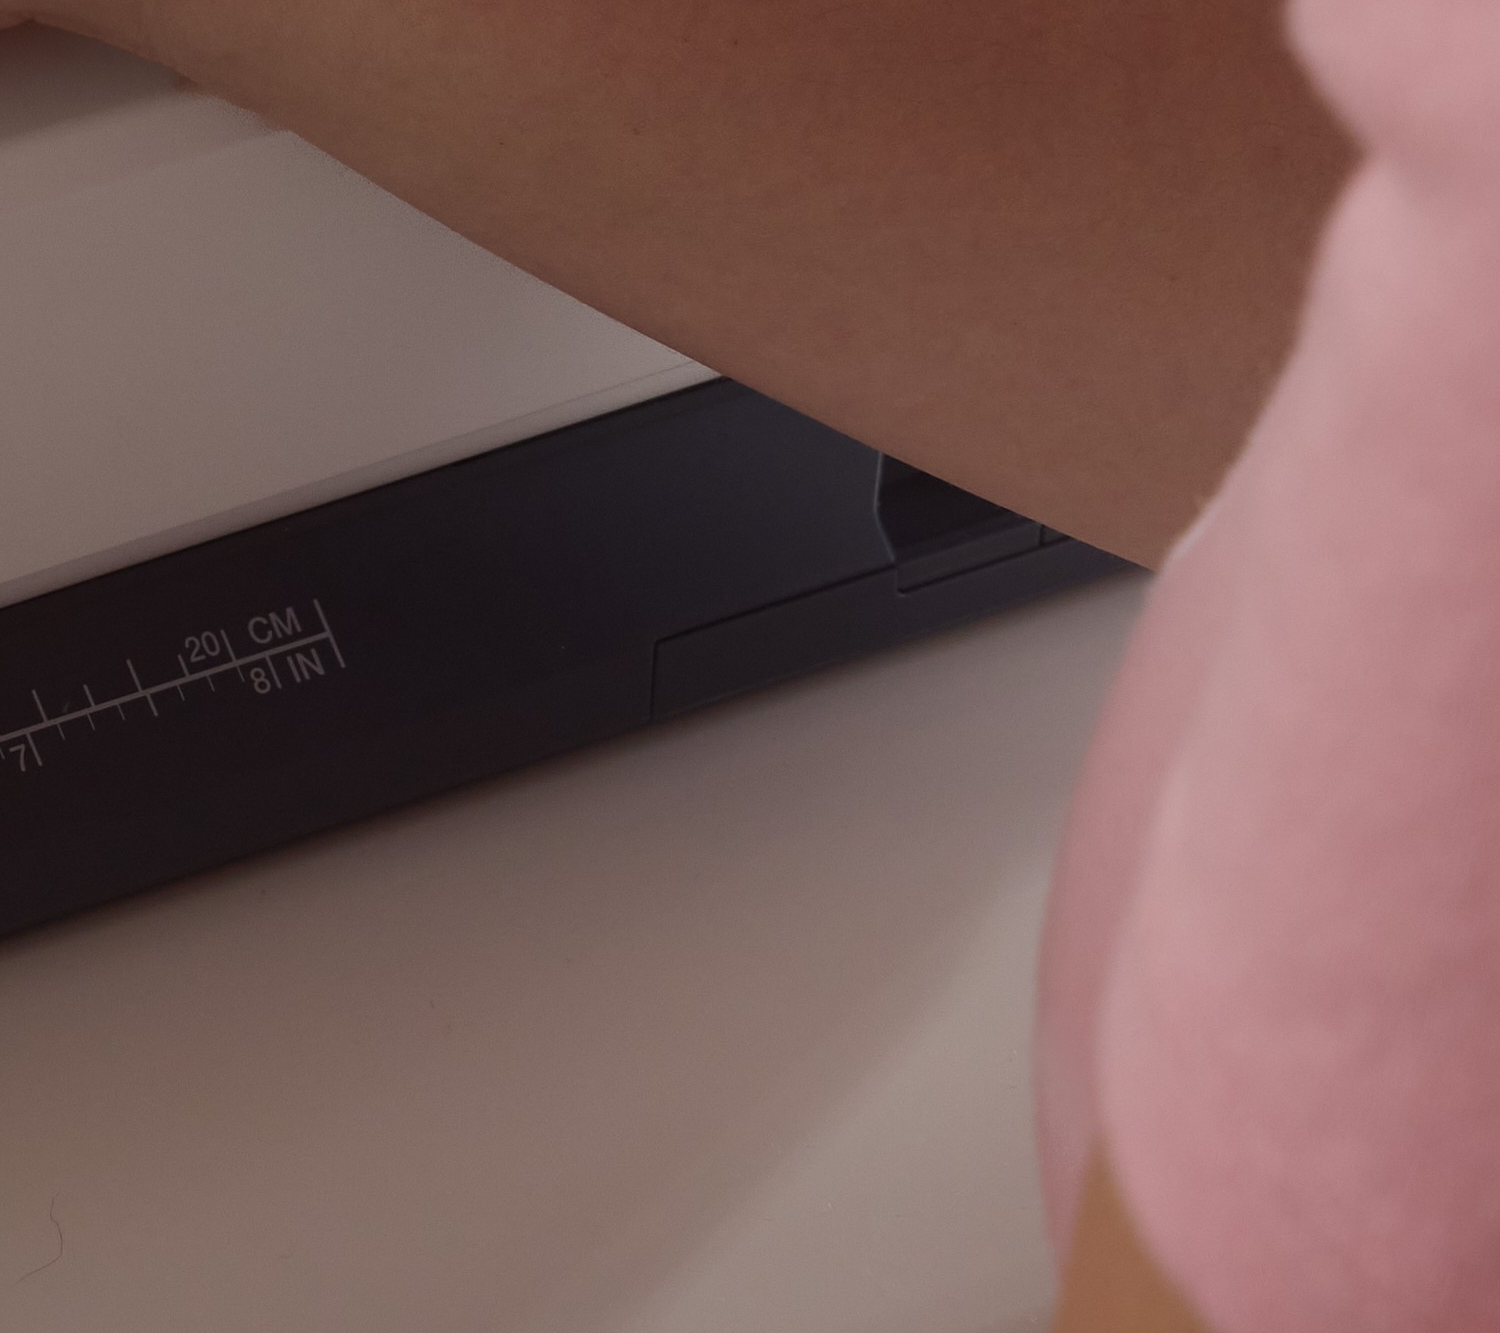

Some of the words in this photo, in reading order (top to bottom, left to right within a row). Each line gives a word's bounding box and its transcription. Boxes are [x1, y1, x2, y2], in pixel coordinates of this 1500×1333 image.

[185, 629, 223, 663] 20
[247, 606, 301, 646] CM
[9, 744, 25, 771] 7
[250, 665, 272, 695] 8
[288, 647, 326, 683] IN
